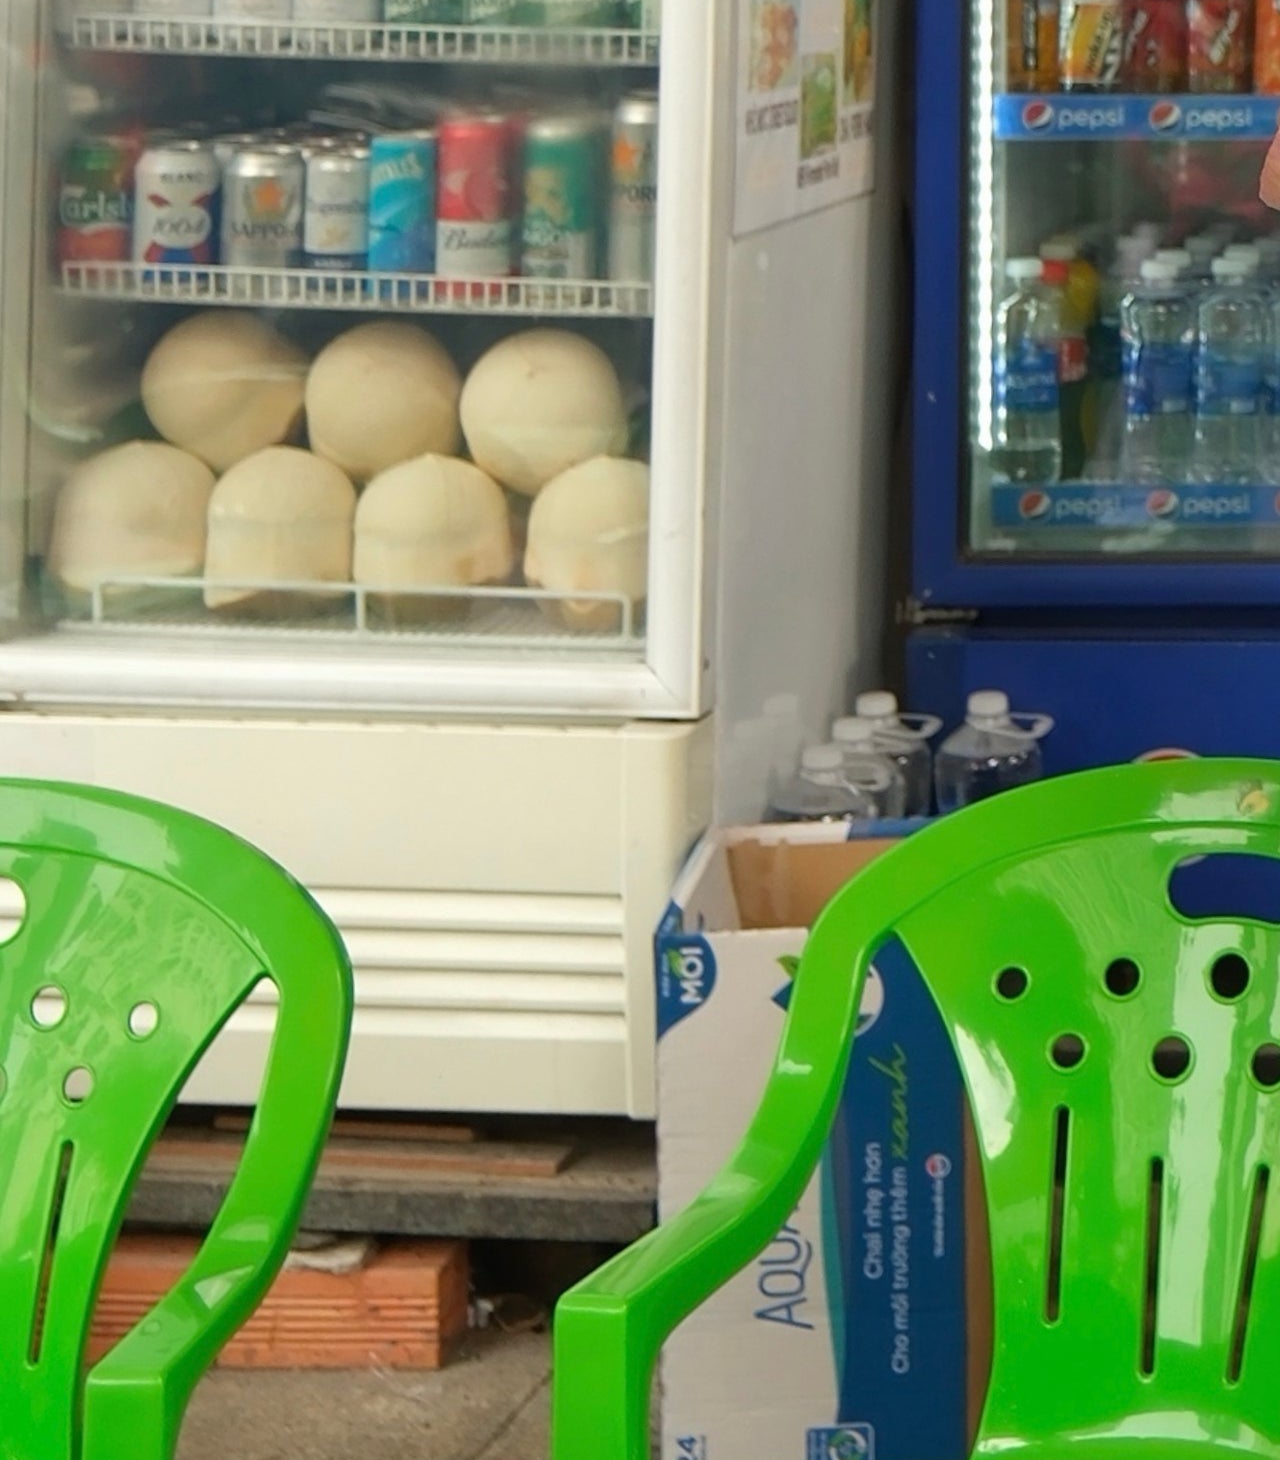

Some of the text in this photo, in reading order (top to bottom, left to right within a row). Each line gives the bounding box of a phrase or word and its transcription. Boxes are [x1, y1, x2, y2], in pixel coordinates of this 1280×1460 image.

[1058, 104, 1125, 130] pepsi
[1185, 104, 1253, 130] pepsi
[1055, 492, 1121, 519] pepsi
[1183, 491, 1250, 518] pepsi
[889, 1166, 909, 1222] thêm
[864, 1232, 884, 1280] Chai
[890, 1293, 910, 1330] môi
[890, 1334, 910, 1374] Cho
